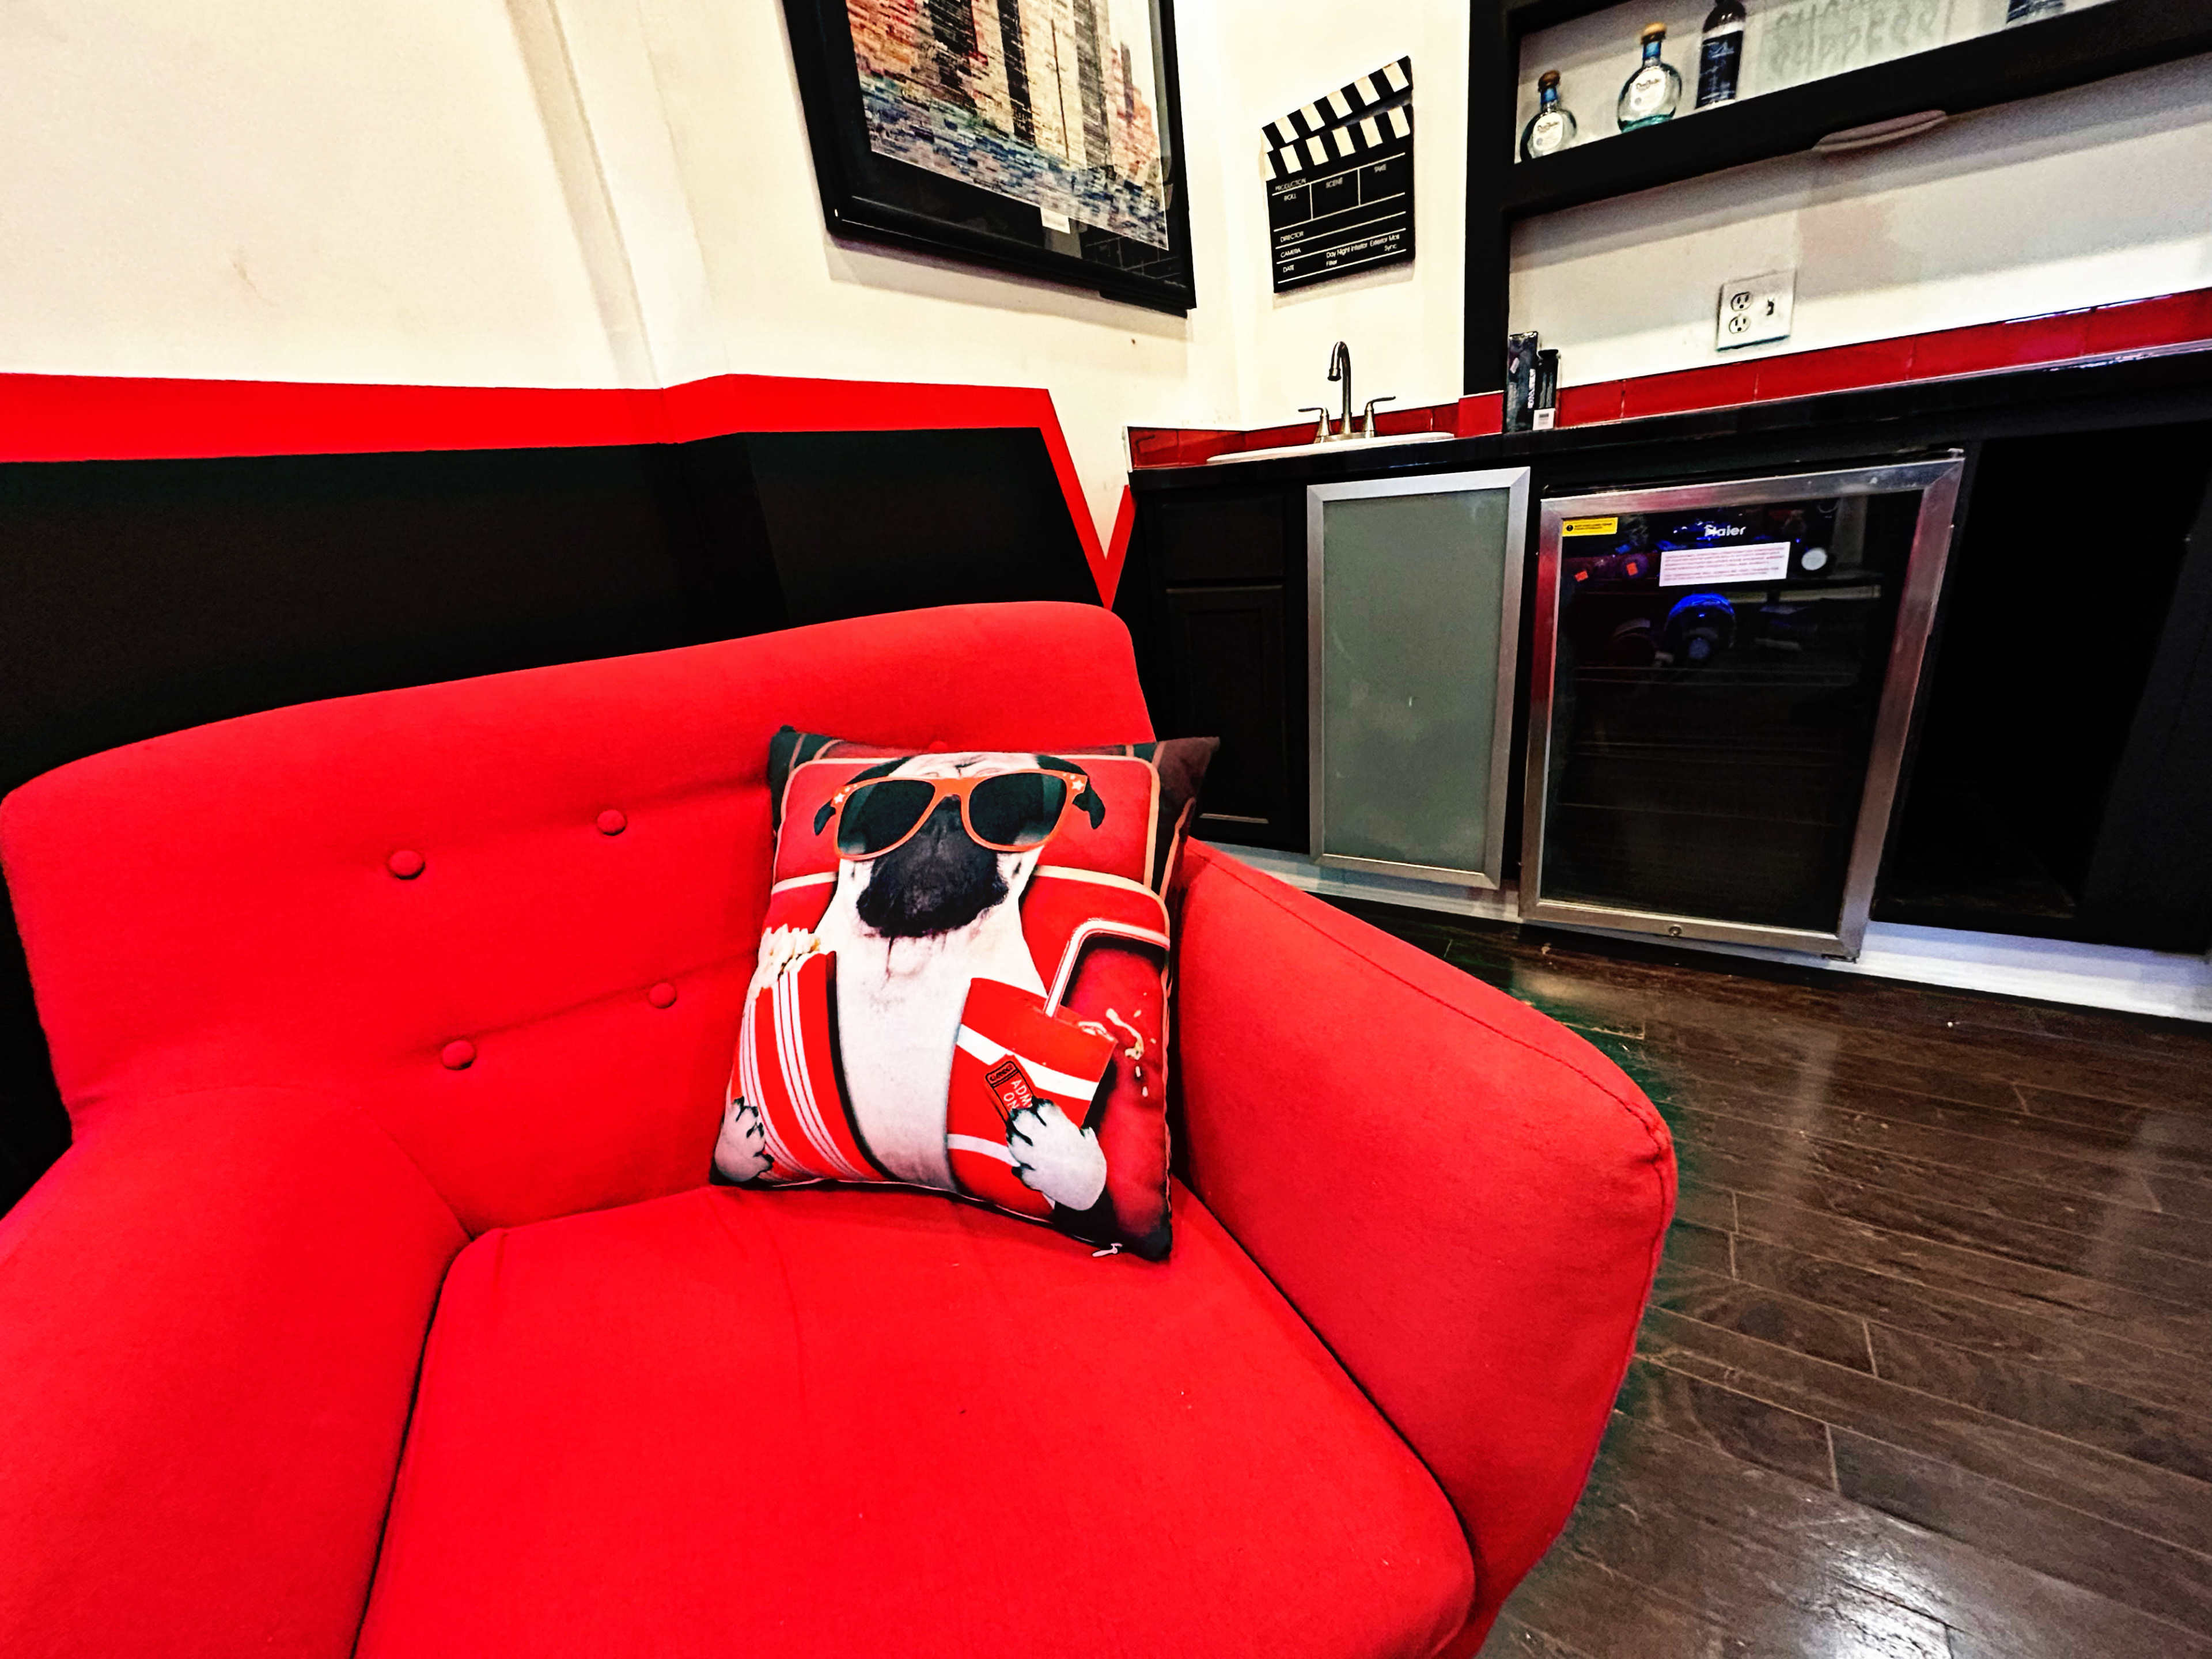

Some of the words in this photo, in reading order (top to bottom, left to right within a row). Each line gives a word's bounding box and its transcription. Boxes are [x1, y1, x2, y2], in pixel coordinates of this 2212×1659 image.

[1325, 177, 1343, 188] SCENE
[1280, 231, 1304, 243] DIRECTOR
[1280, 248, 1301, 258] CAMERA
[1337, 247, 1350, 256] Night
[1384, 244, 1397, 252] Sync
[1283, 264, 1295, 273] DATE
[1704, 524, 1747, 537] Haier
